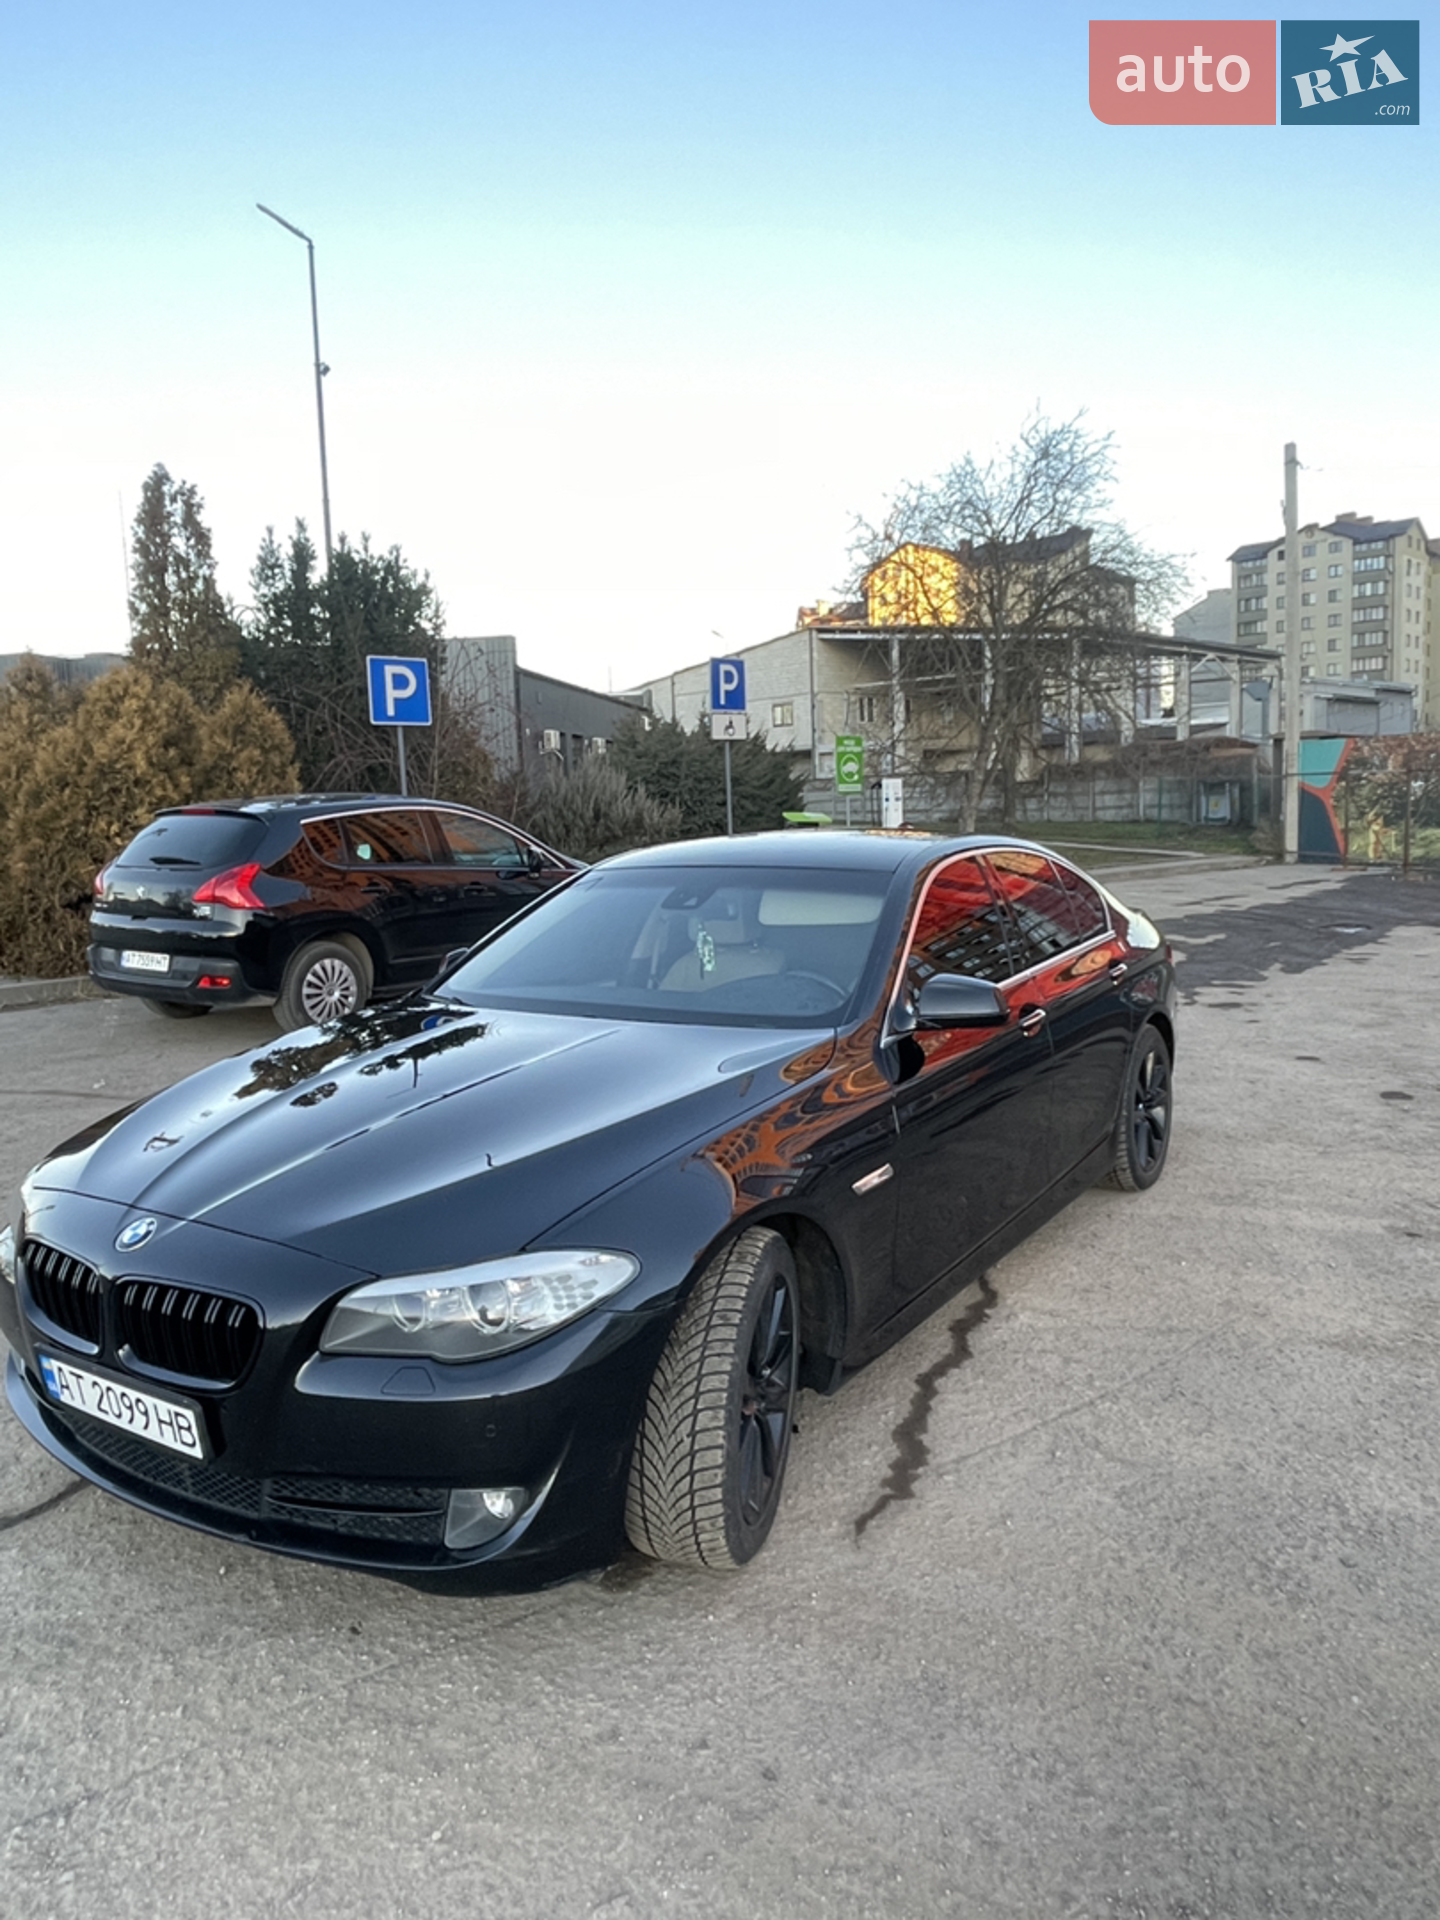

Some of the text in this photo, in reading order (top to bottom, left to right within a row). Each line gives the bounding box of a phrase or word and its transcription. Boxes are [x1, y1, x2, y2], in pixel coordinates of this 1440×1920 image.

[383, 664, 417, 717] P
[719, 663, 739, 705] P
[57, 1366, 197, 1449] AT 2099 HB
